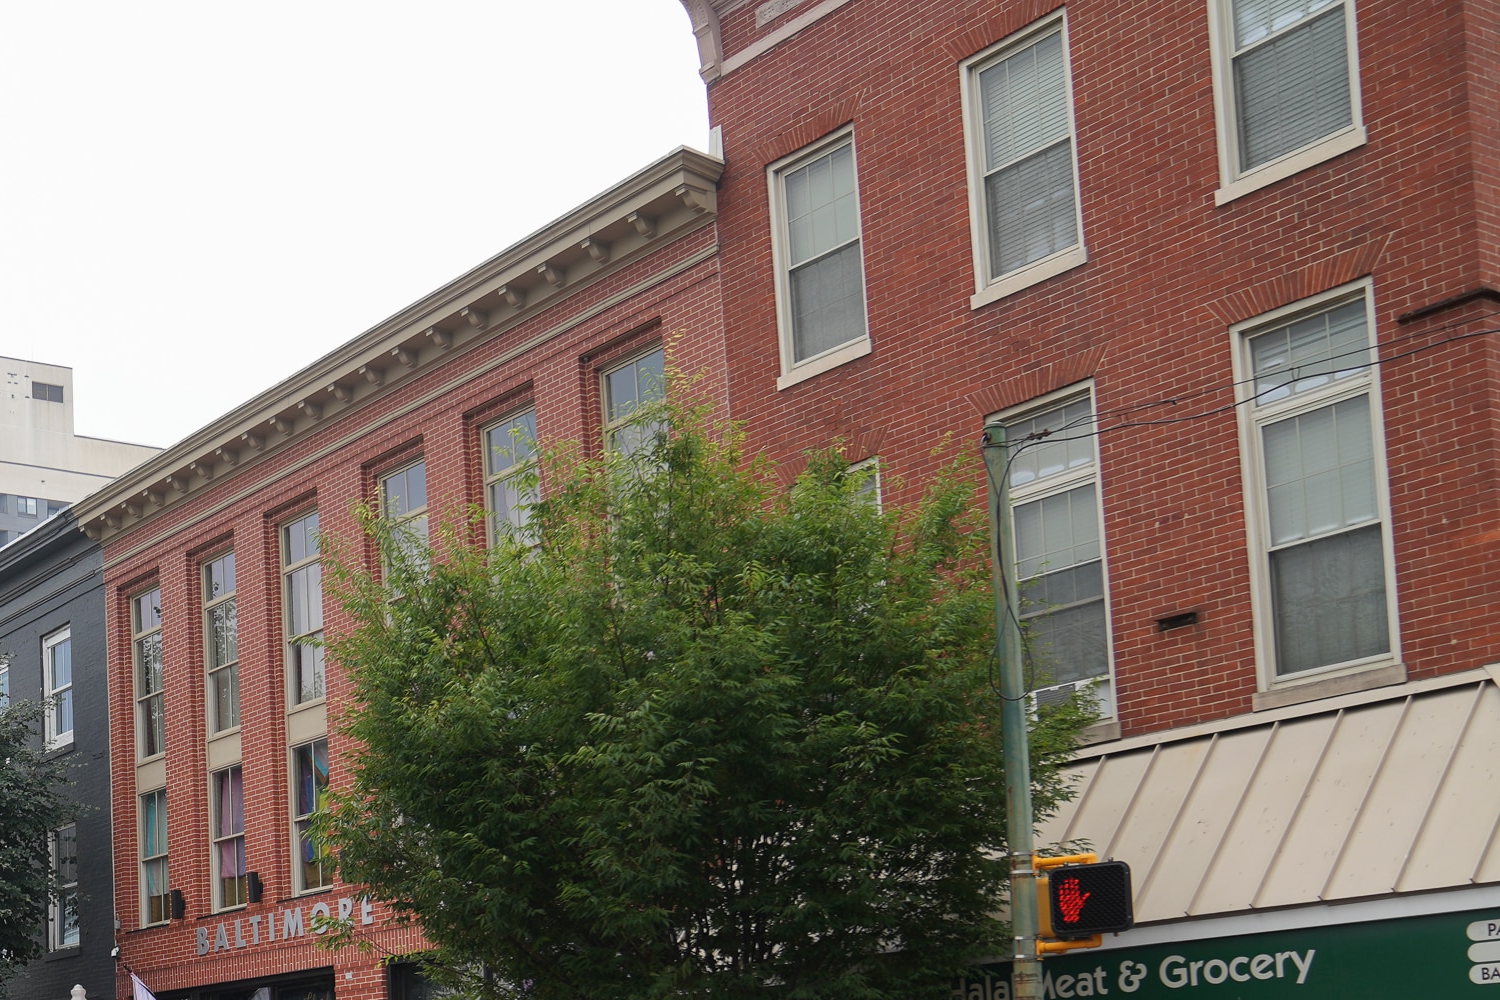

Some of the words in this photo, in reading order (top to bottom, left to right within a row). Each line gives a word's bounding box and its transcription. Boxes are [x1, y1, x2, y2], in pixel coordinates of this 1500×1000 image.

[196, 894, 374, 956] BALTIMORE
[1118, 960, 1148, 993] &
[1159, 949, 1317, 989] Grocery
